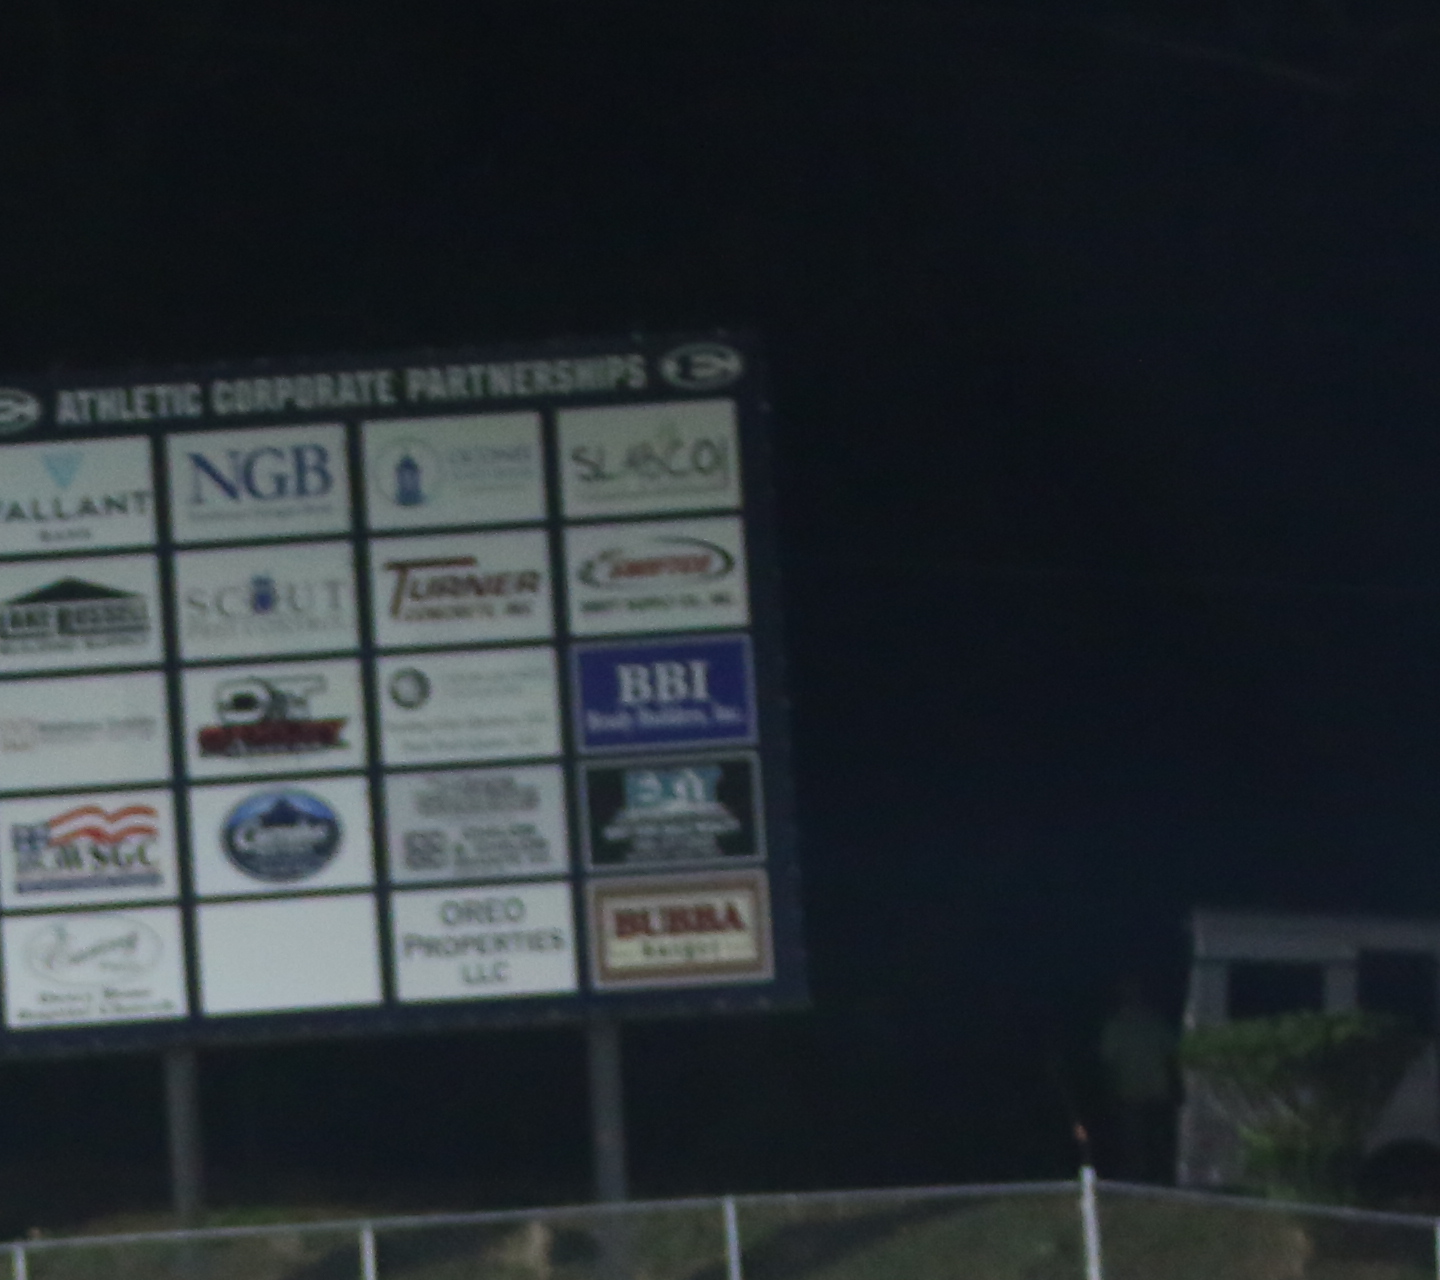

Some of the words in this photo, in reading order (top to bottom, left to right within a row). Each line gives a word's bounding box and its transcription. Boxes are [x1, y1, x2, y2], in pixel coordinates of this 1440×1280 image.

[55, 382, 203, 426] ATHLETIC
[211, 368, 398, 415] CORPORATE
[404, 353, 647, 401] PARTNERSHIPS
[186, 443, 335, 505] NGB
[384, 556, 541, 621] TURNER
[615, 660, 709, 703] BBI
[440, 897, 526, 927] OREO
[613, 903, 746, 940] BUBBA
[403, 928, 566, 959] PROPERTIES
[460, 959, 511, 985] LLC
